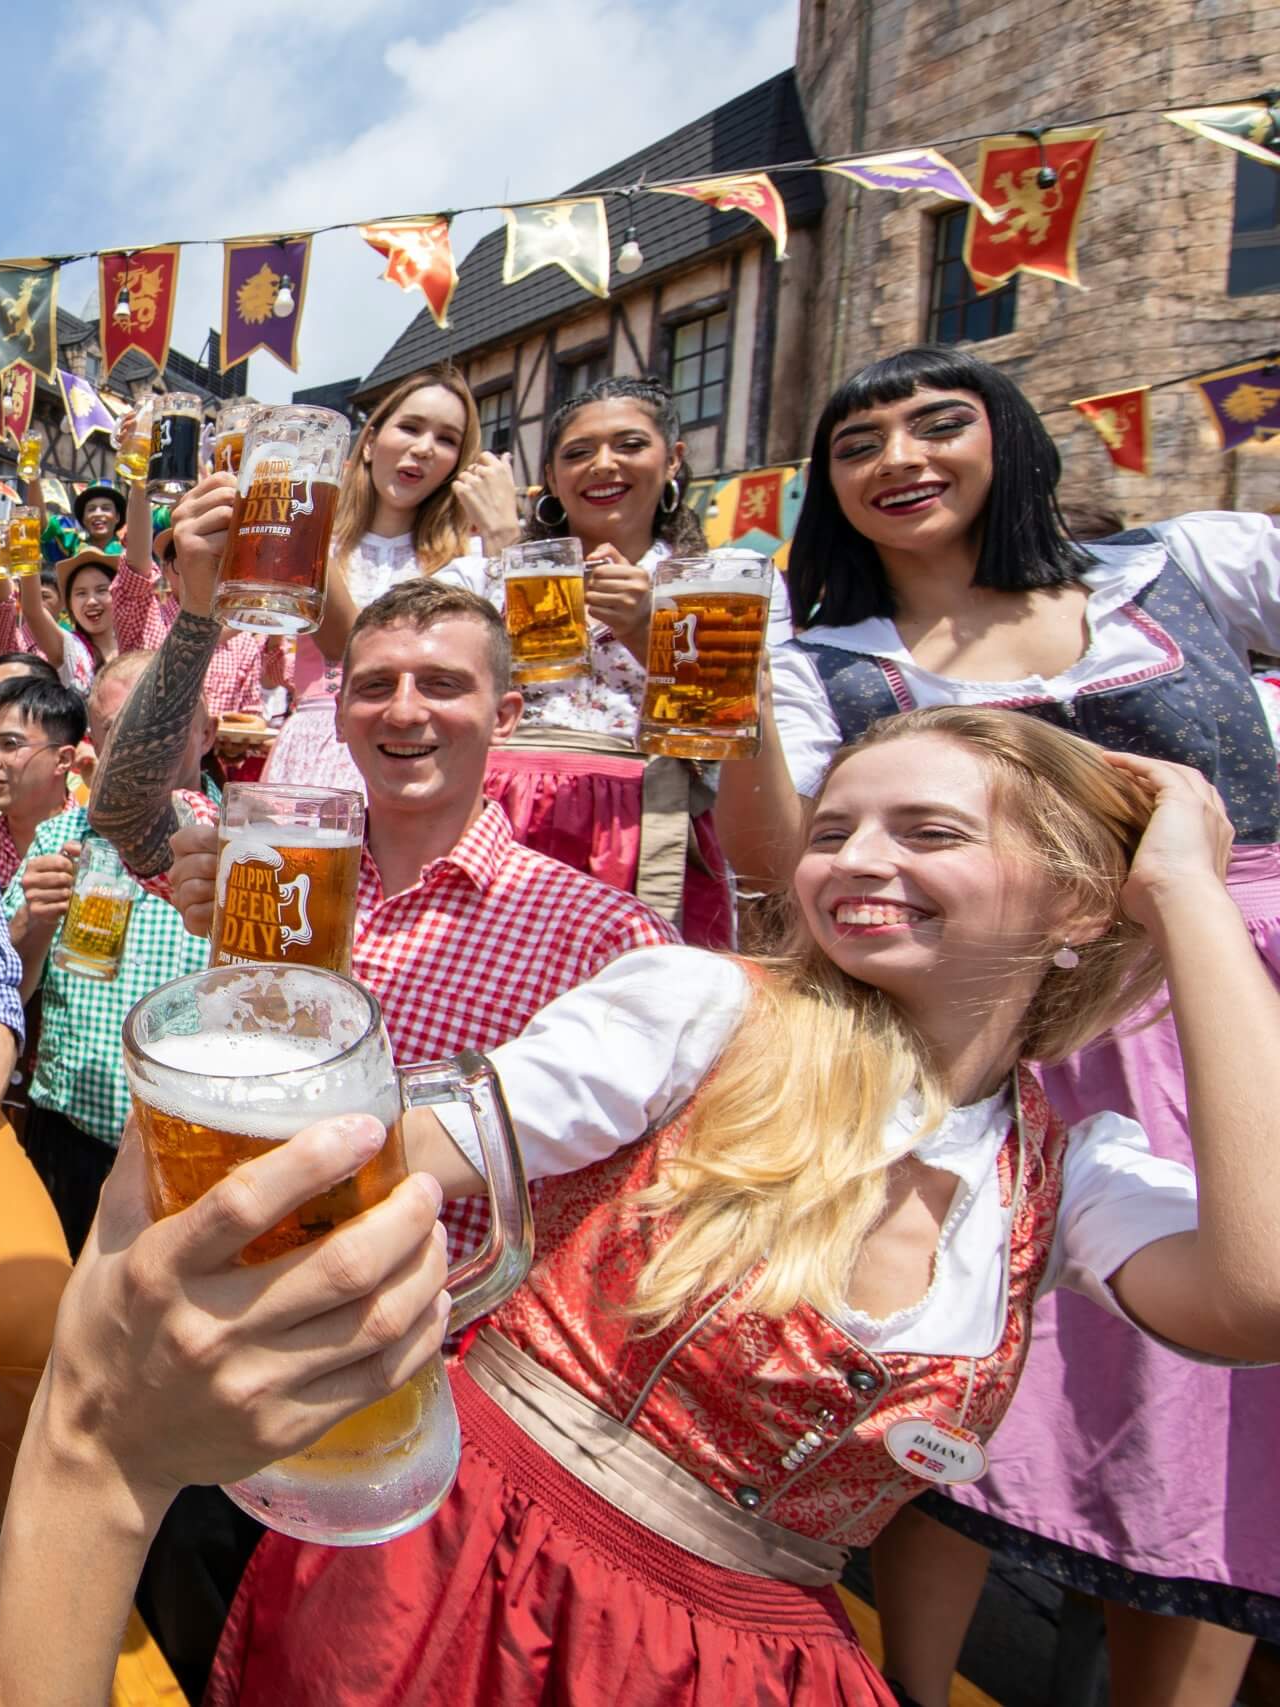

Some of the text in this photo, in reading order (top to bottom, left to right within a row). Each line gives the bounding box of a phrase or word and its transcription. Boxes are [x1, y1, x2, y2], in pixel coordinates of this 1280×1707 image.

[248, 477, 290, 499] BEER
[242, 499, 289, 523] DAY
[230, 863, 273, 893] HAPPY
[226, 886, 278, 924] BEER
[222, 914, 277, 957] DAY
[912, 1434, 966, 1465] DAIANA
